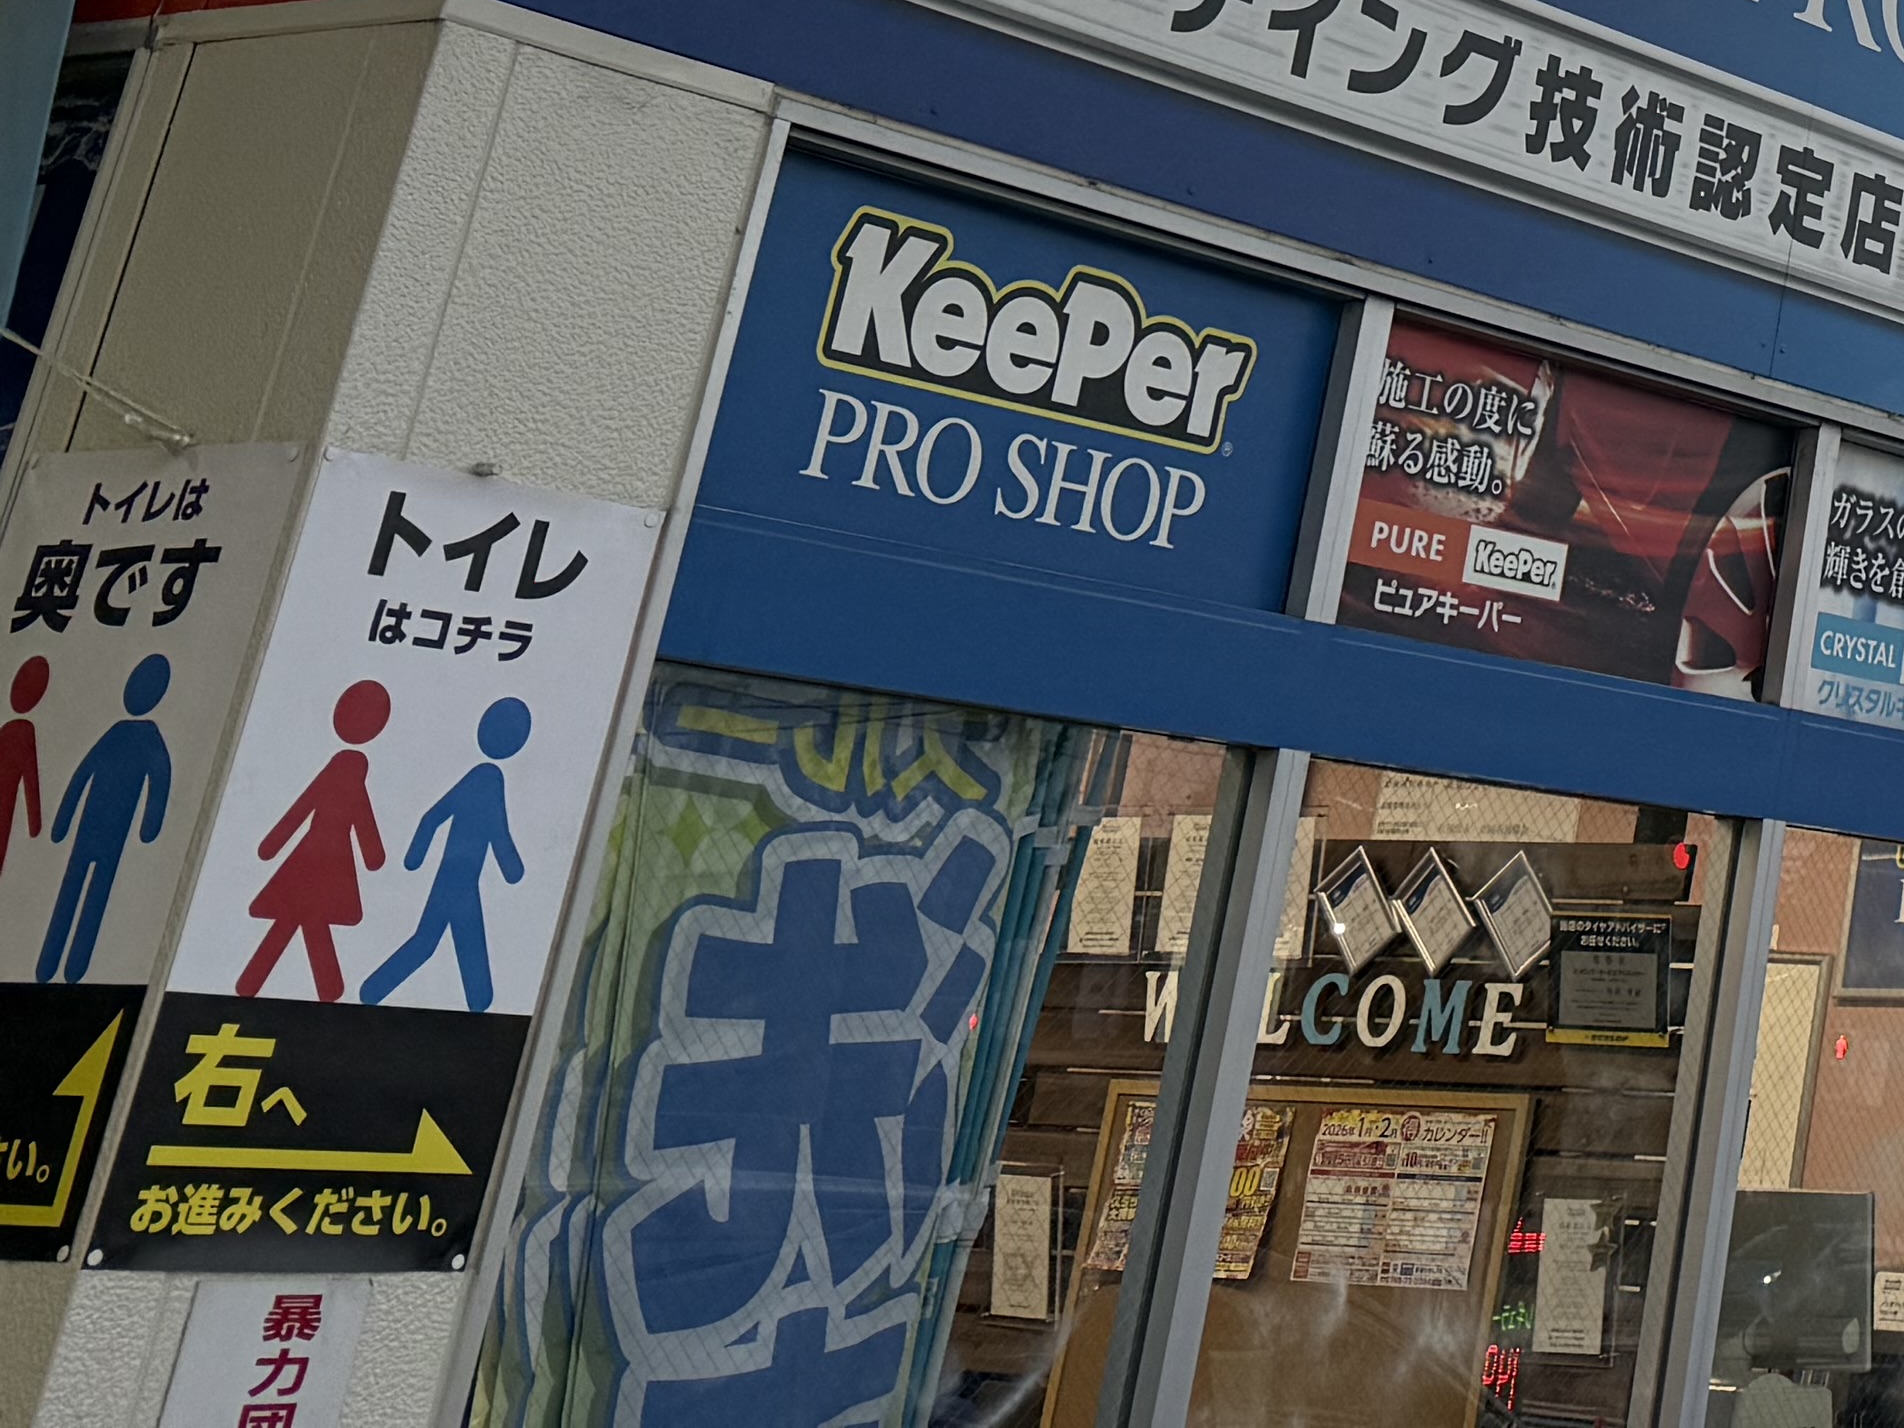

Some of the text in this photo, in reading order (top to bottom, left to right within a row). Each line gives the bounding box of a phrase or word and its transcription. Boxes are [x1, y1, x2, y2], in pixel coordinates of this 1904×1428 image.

[829, 221, 1246, 438] KeePer
[1378, 357, 1536, 436] 施工の度に
[799, 388, 1207, 550] PRO SHOP
[1365, 421, 1503, 495] 蘇る感動。
[82, 477, 210, 526] トイレは
[367, 490, 589, 600] トイレ
[1370, 521, 1557, 589] PURE KeePer
[10, 538, 222, 634] 奥です
[1373, 578, 1522, 632] ピュアキーパー
[368, 599, 534, 662] はコチラ
[1819, 630, 1897, 668] CRYSTAL
[1143, 970, 1524, 1057] WLCOME
[174, 1023, 307, 1126] 右へ
[0, 1137, 50, 1183] い。
[130, 1184, 447, 1237] お進みください。
